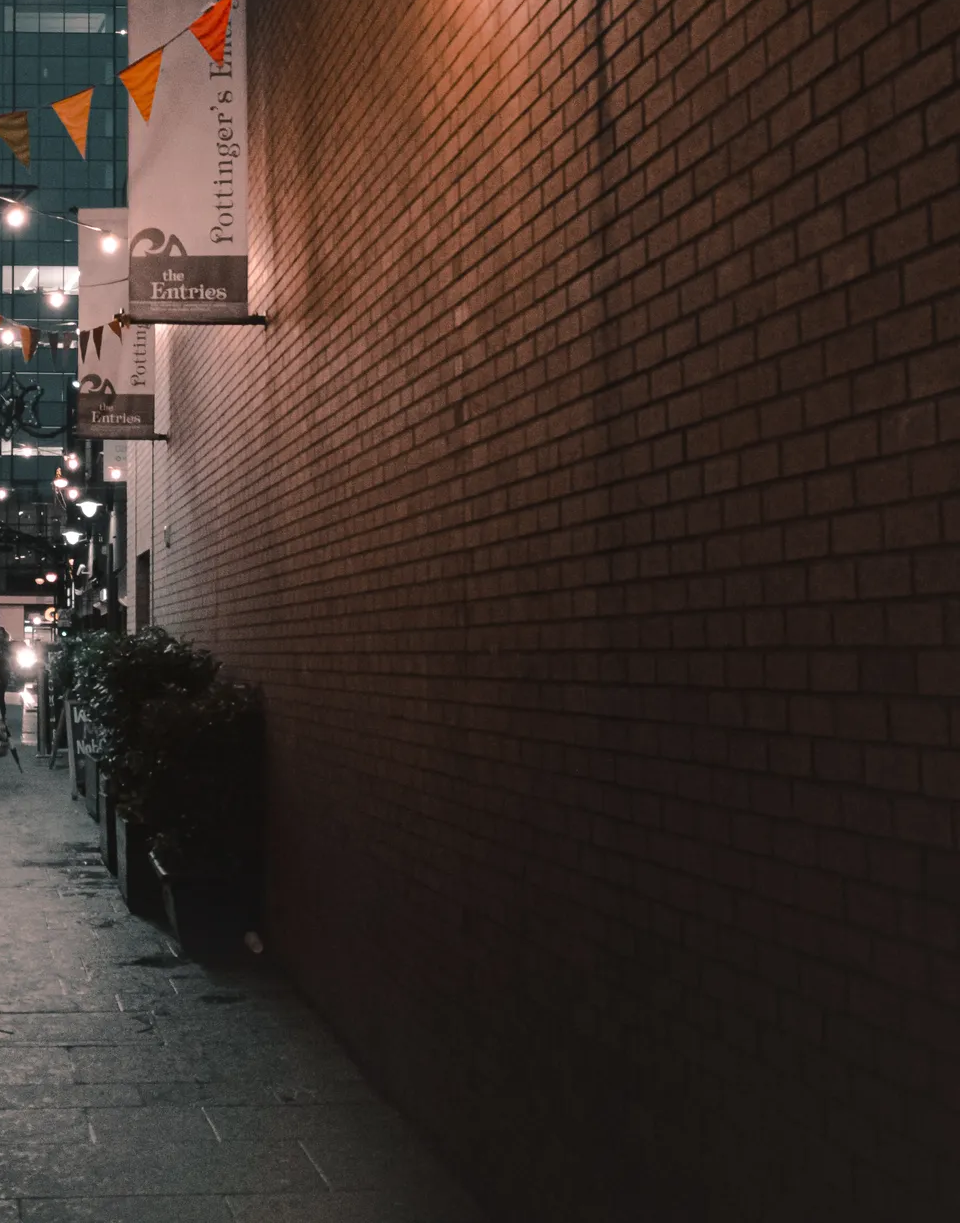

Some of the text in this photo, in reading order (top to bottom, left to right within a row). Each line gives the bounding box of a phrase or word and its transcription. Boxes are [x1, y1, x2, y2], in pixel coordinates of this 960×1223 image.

[209, 90, 241, 245] Pottinger's
[162, 269, 185, 282] the
[150, 281, 227, 300] Entries
[130, 324, 151, 387] Potting
[91, 411, 141, 424] Entries
